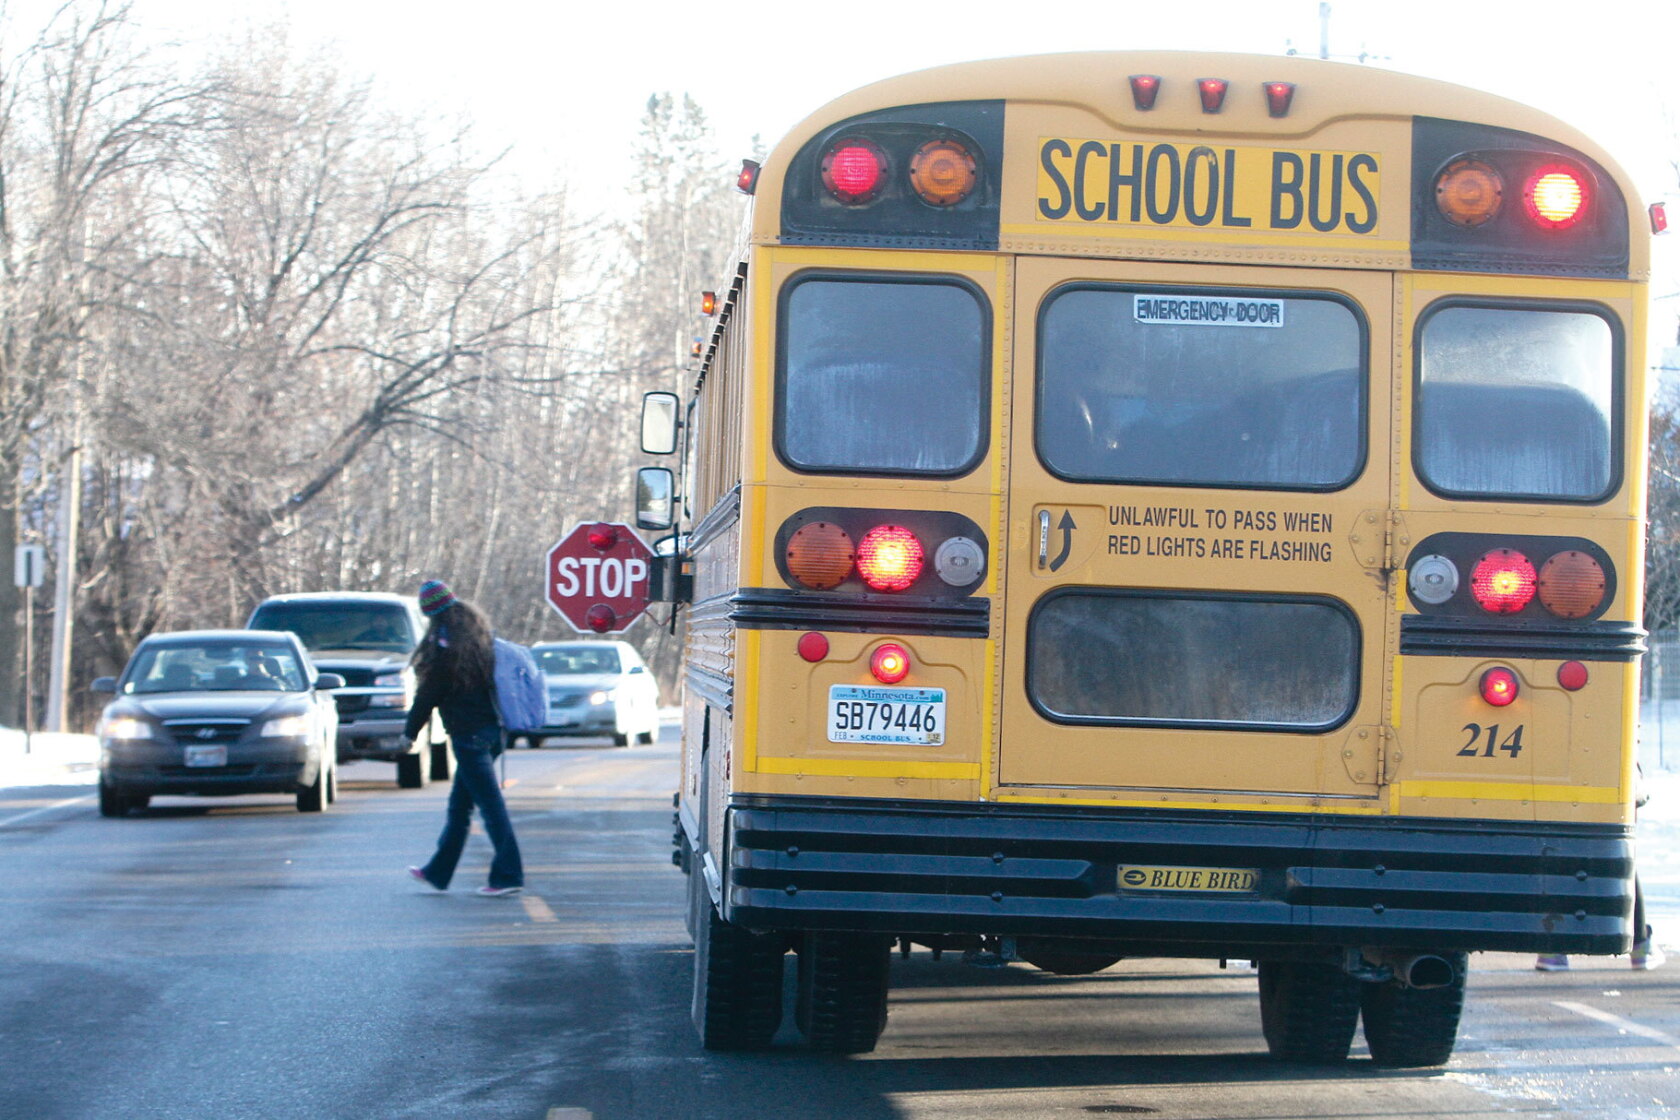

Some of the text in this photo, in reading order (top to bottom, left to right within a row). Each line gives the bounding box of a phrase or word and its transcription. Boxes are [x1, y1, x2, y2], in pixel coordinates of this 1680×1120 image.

[1038, 138, 1379, 234] SCHOOL BUS
[1137, 299, 1280, 323] EMERGENCY DOOR
[1109, 505, 1333, 533] UNLAWFUL TO PASS WHEN
[1108, 534, 1332, 562] RED LIGHTS ARE FLASHING
[556, 556, 647, 598] STOP
[836, 701, 936, 732] SB79446
[834, 731, 847, 740] FEB
[1456, 722, 1524, 758] 214
[1150, 870, 1256, 890] BLUE BIRD
